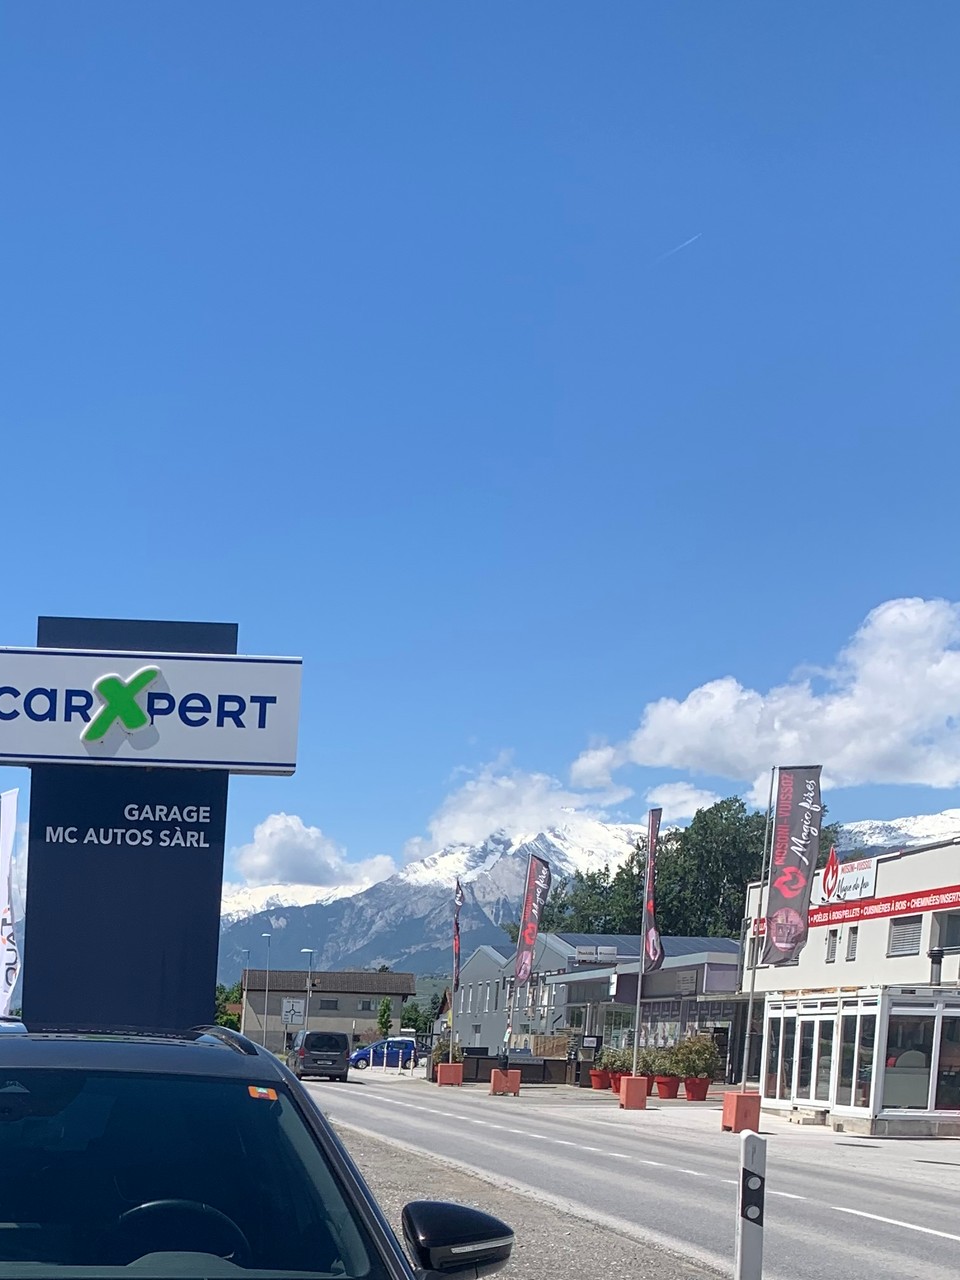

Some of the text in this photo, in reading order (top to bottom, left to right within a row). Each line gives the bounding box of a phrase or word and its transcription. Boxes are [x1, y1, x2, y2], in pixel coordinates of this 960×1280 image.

[124, 803, 211, 824] GARAGE
[45, 826, 210, 848] MC AUTOS SÀRL
